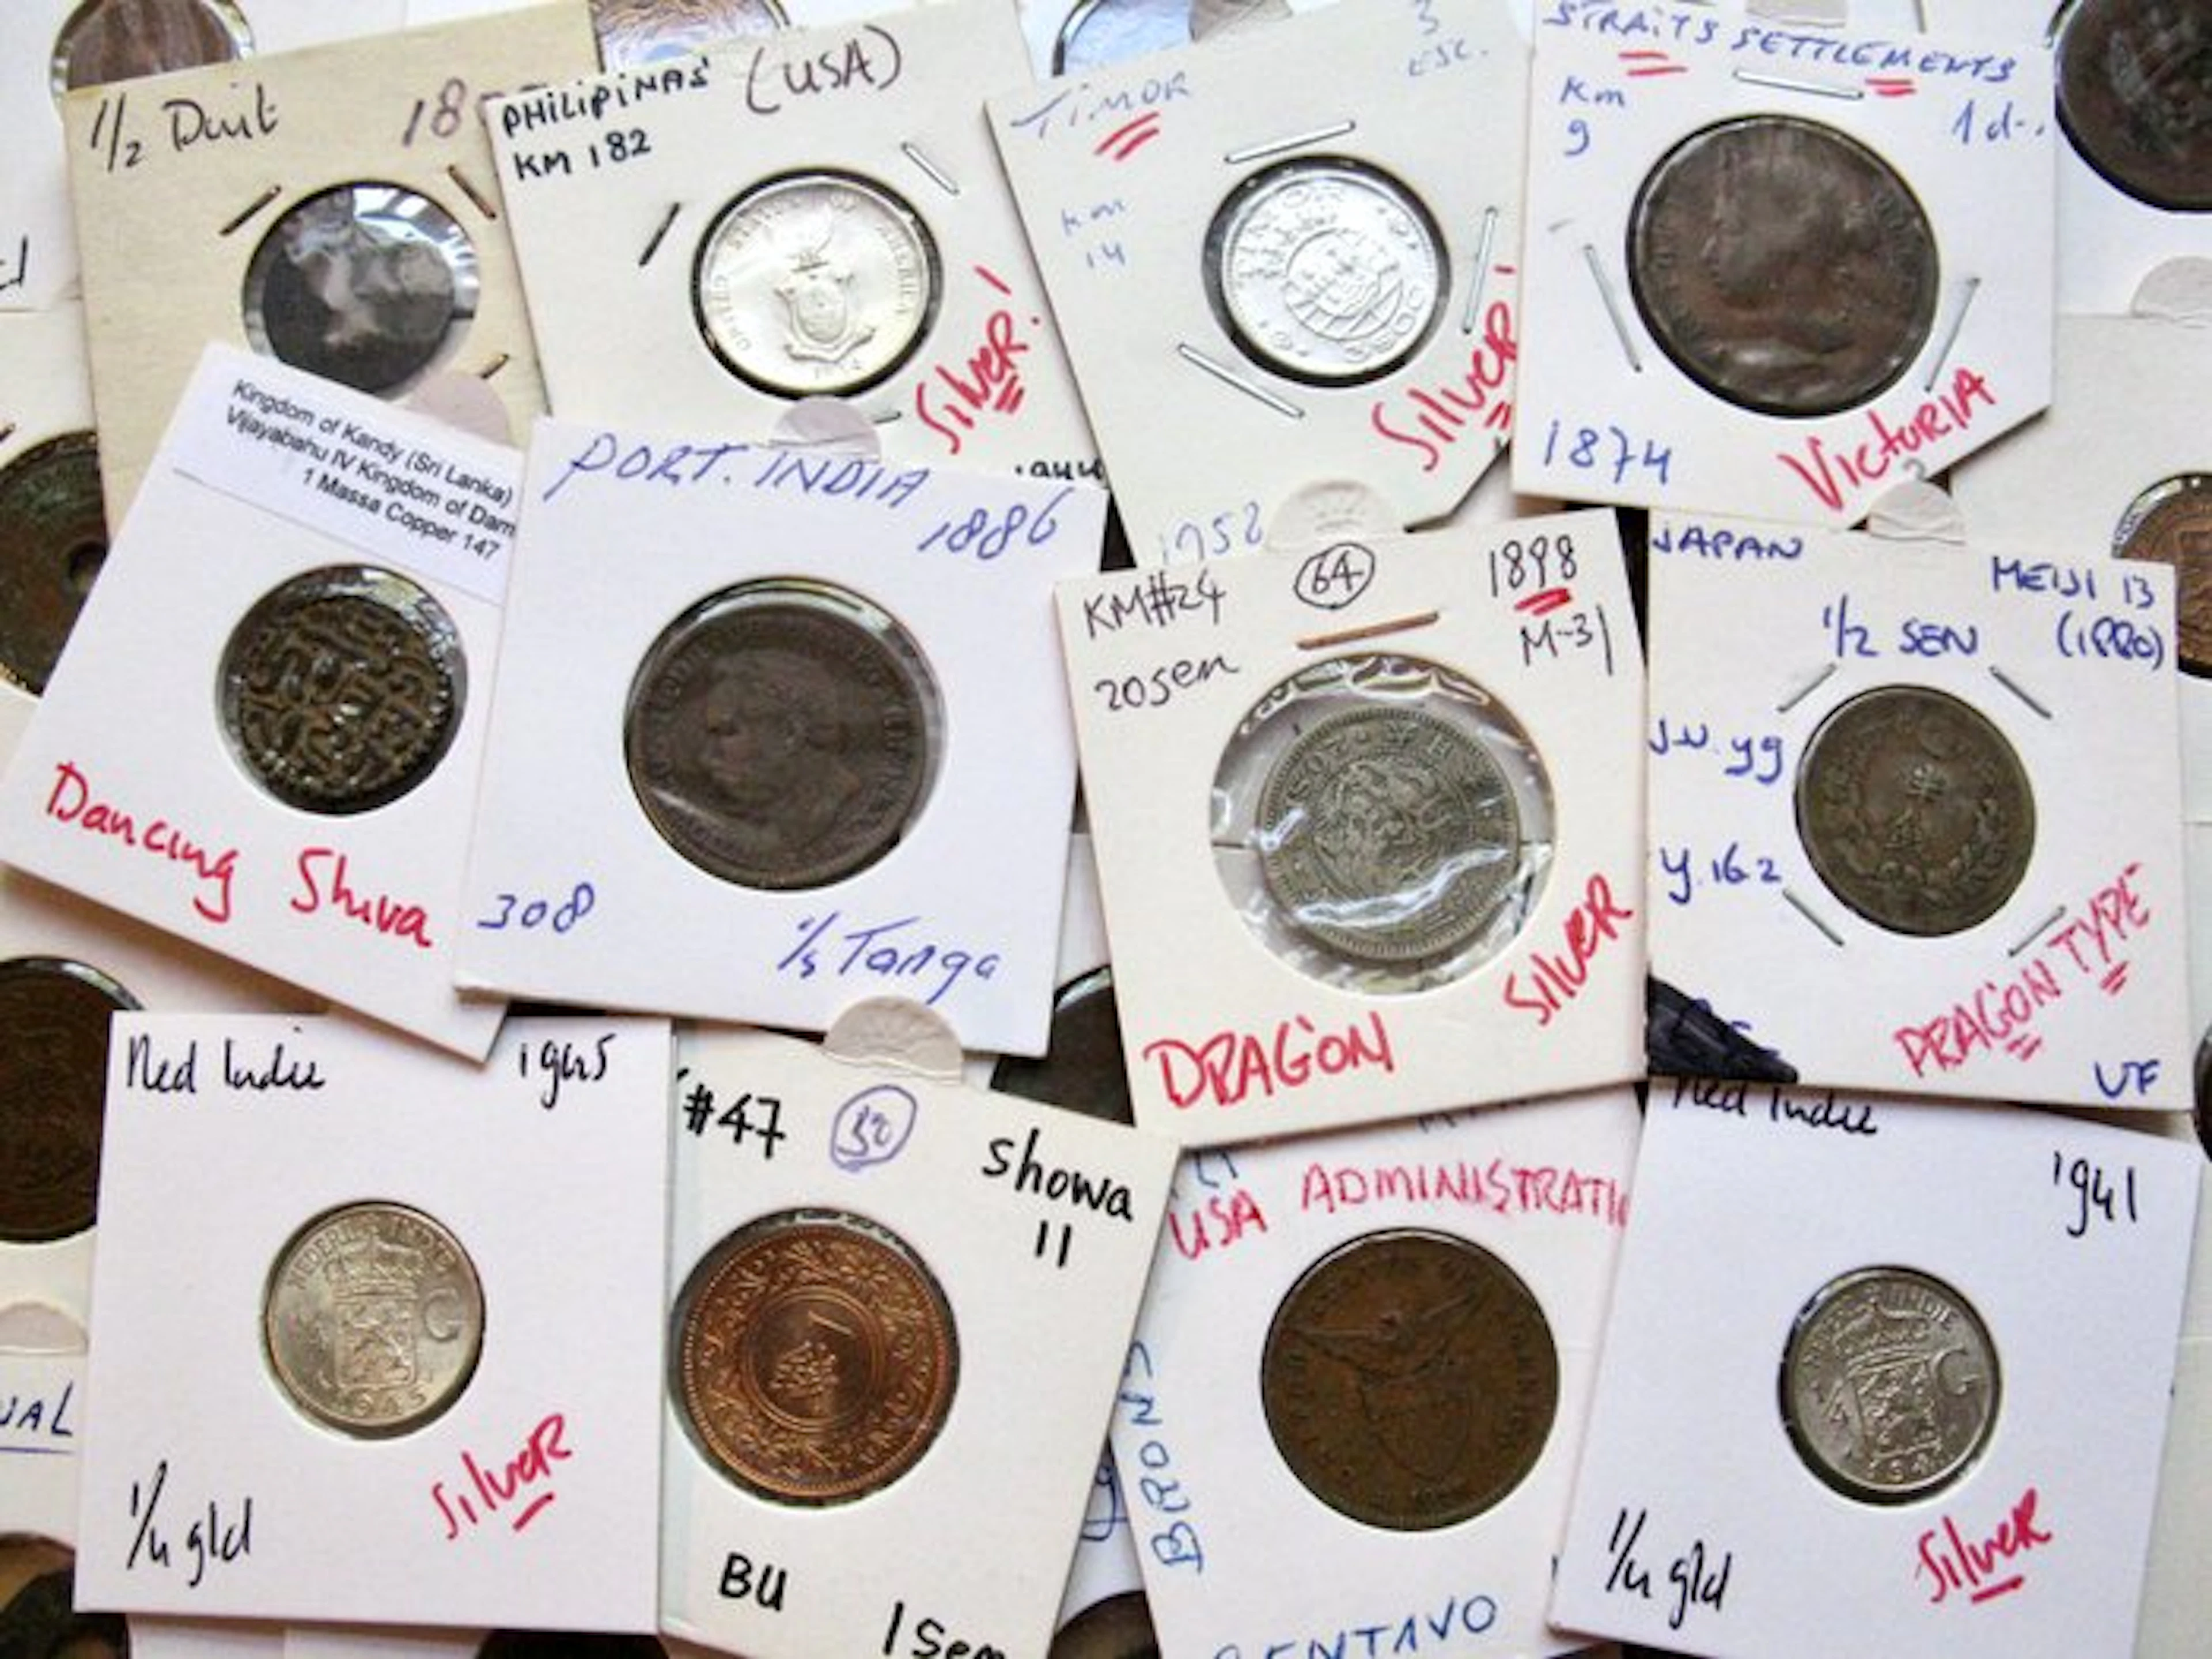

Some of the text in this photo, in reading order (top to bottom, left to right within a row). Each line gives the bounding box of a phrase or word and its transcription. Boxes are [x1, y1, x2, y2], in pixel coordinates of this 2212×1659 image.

[1733, 29, 2016, 82] SETTLEMENTS
[513, 128, 652, 181] KM 182
[1566, 122, 1590, 156] 9
[226, 405, 328, 461] Vijayabahu
[330, 449, 357, 471] IV
[356, 460, 440, 509] Kingdom
[444, 500, 468, 517] of
[233, 379, 514, 509] Kingdom of Kandy (Sri Lanka)
[1544, 420, 1672, 486] 1874
[754, 457, 930, 507] INDIA
[316, 474, 381, 514] Massa
[384, 500, 458, 544] Copper
[463, 533, 501, 561] 147
[917, 487, 1074, 561] 1886
[1651, 526, 1803, 560] JAPAN
[1312, 551, 1364, 594] 64
[1490, 534, 1577, 599] 1898
[1992, 555, 2154, 609] MEIJI 13
[1899, 621, 1978, 657] SEN
[43, 760, 433, 949] Dancing Shiva
[476, 881, 595, 934] 308
[1892, 959, 2063, 1078] DRAGON
[2048, 861, 2153, 975] TYPE
[126, 1033, 197, 1094] Ned
[1142, 1011, 1395, 1109] DRAGON
[682, 1082, 787, 1161] #47
[1171, 1189, 1267, 1260] USA
[718, 1552, 787, 1612] BU
[1213, 1594, 1498, 1659] NTAVO
